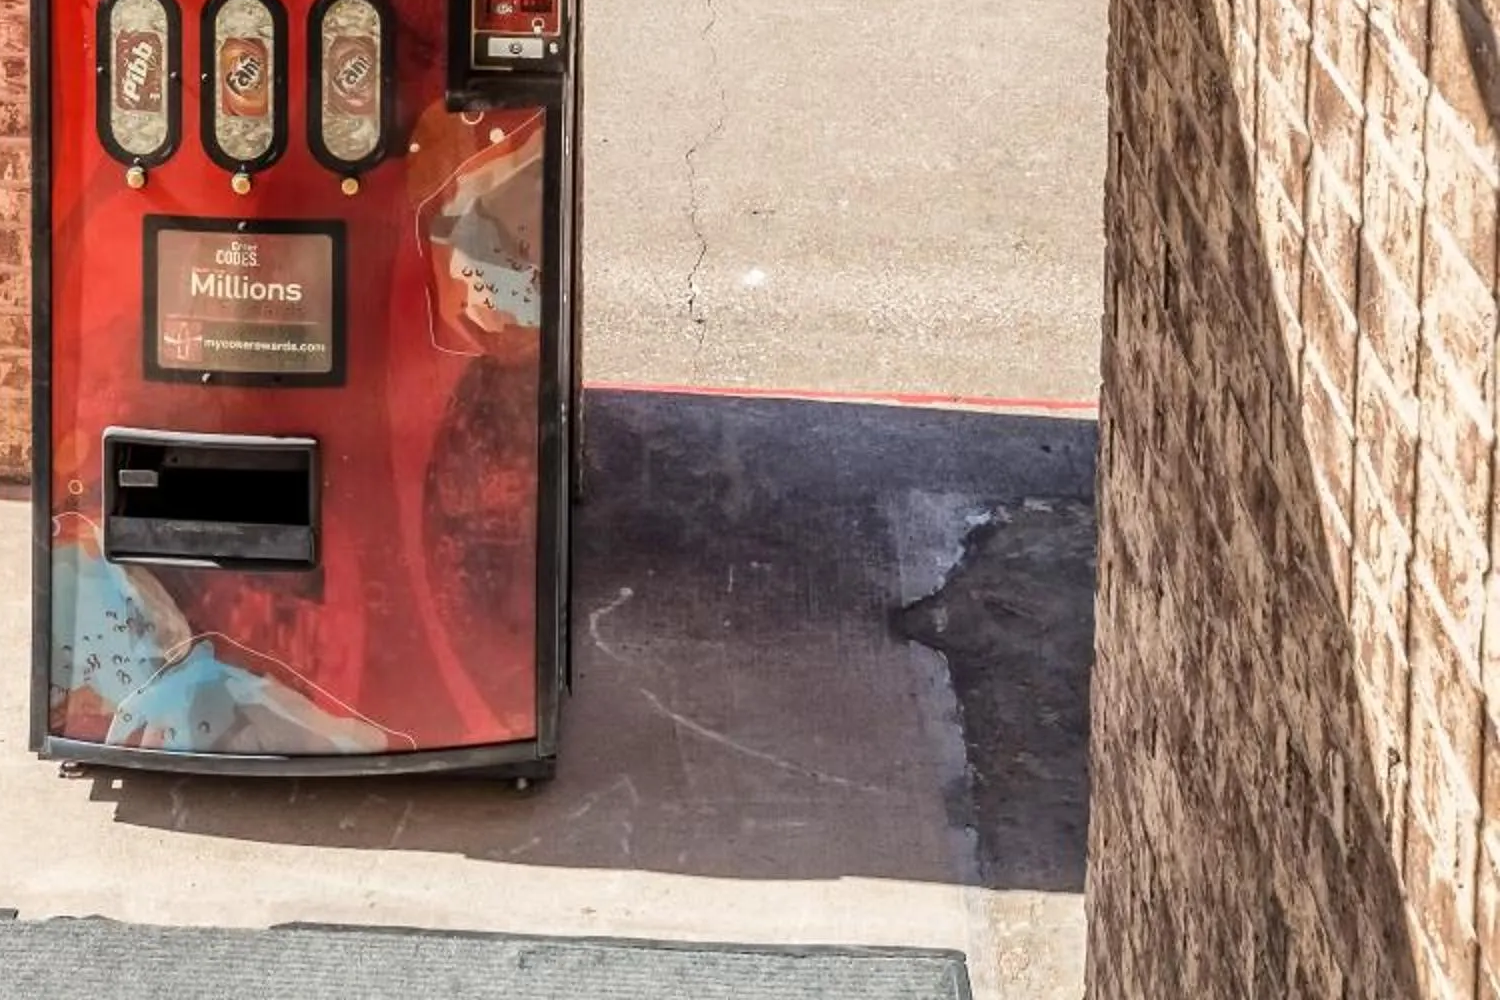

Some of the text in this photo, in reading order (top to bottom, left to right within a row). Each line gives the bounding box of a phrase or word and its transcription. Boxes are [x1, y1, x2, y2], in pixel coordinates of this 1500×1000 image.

[227, 55, 262, 95] Fant
[334, 55, 373, 96] Fant
[191, 271, 302, 301] Millions
